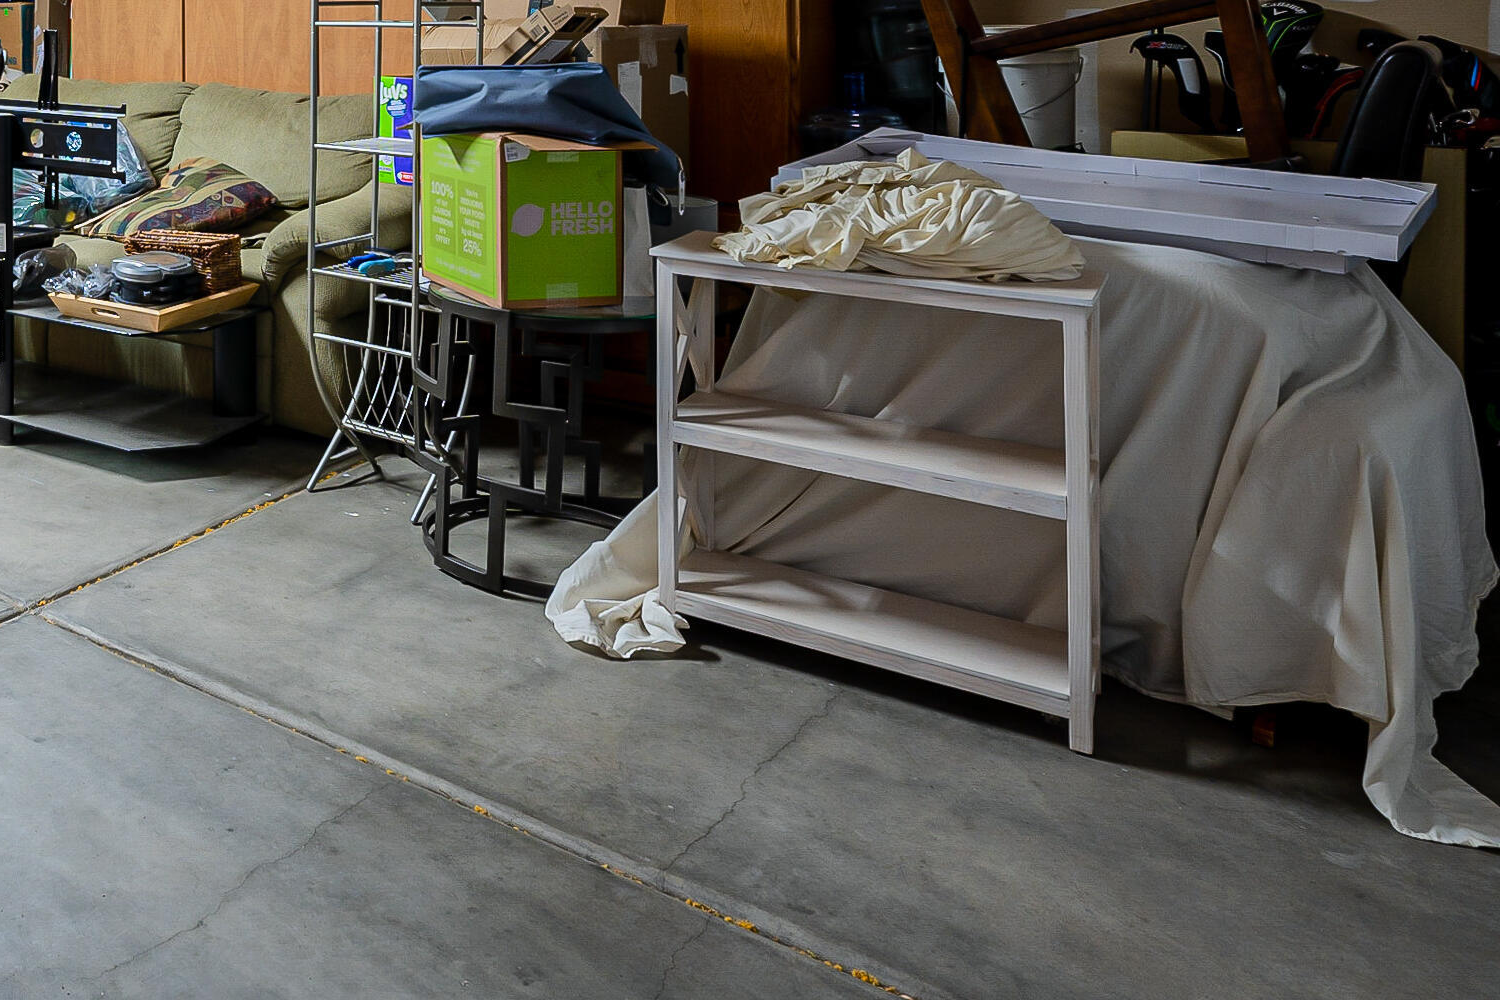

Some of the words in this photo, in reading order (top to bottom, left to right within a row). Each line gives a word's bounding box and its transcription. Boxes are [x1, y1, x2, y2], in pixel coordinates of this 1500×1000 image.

[430, 180, 454, 199] 100%
[550, 200, 614, 218] HELLO
[550, 218, 614, 237] FRESH
[463, 239, 483, 257] 25%
